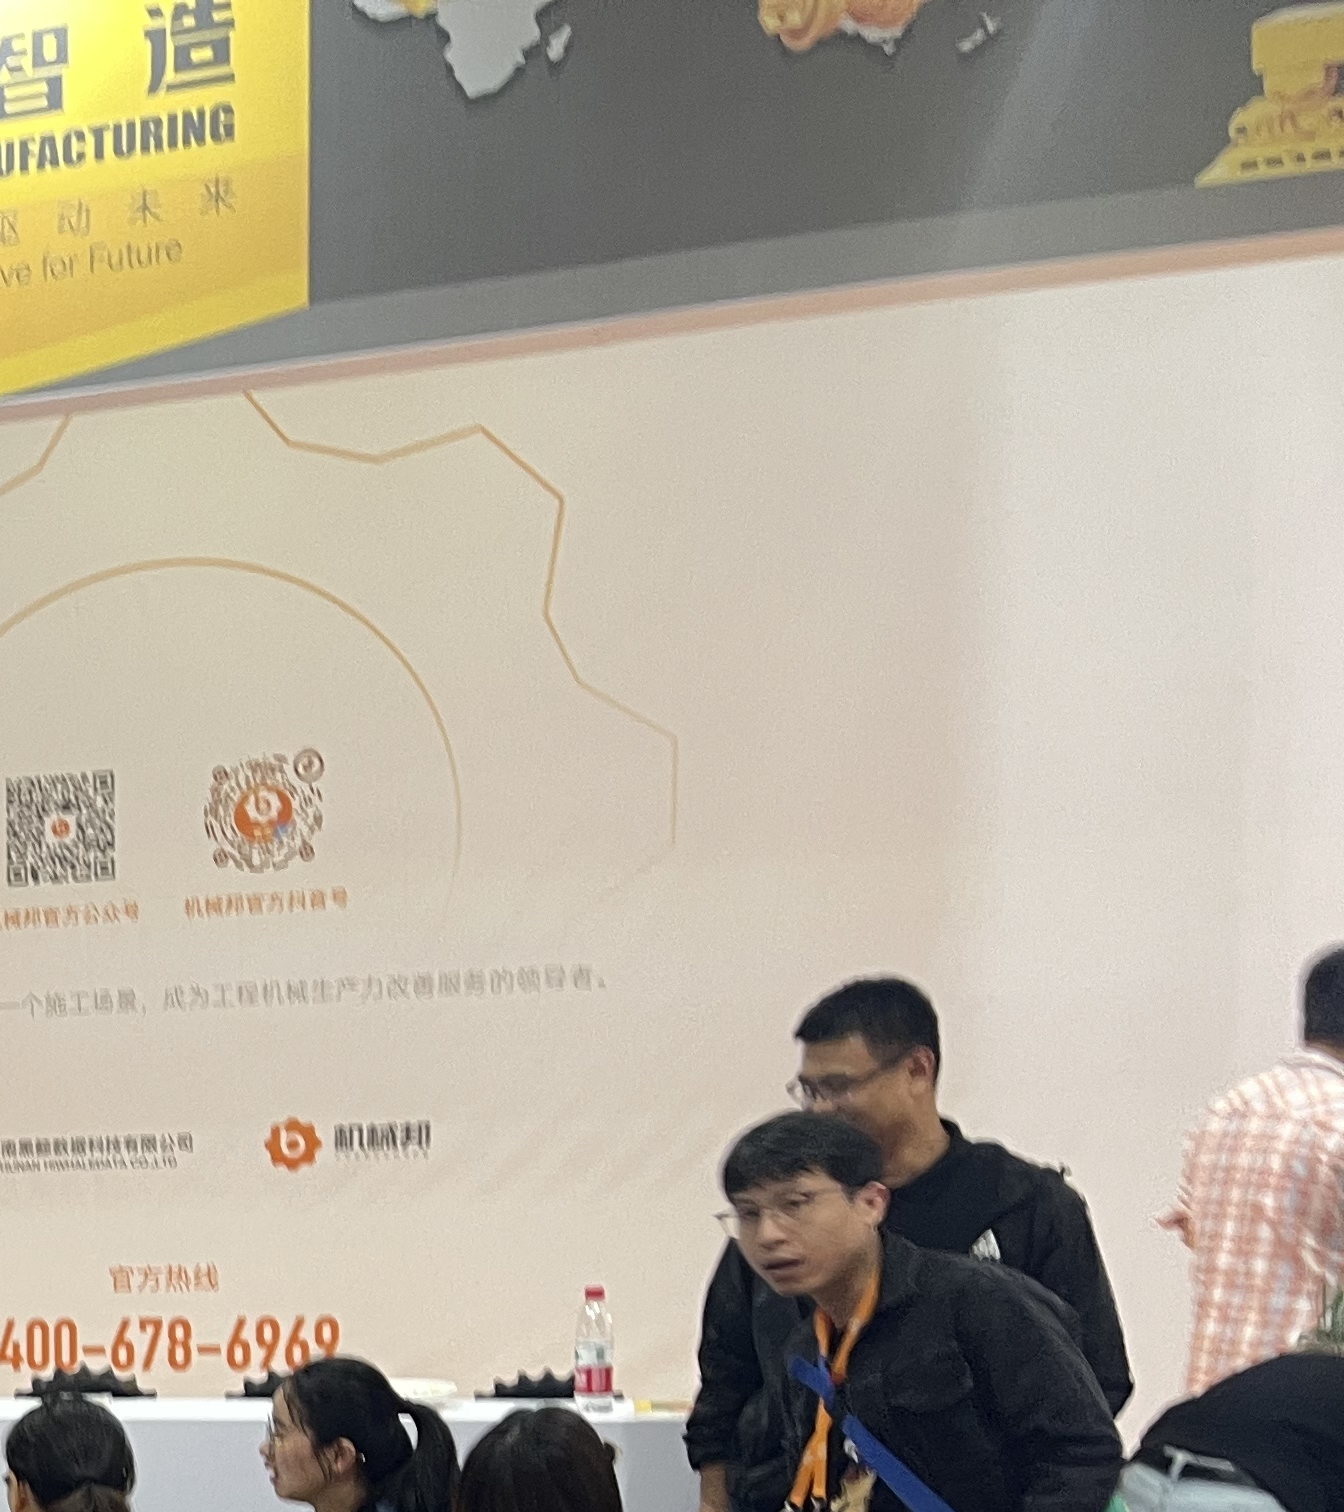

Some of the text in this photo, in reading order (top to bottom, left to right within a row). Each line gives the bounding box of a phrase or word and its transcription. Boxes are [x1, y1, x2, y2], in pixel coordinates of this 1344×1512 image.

[42, 248, 80, 283] for
[89, 236, 185, 276] Future
[332, 1117, 433, 1153] 机械邦
[107, 1259, 221, 1296] 官方热线
